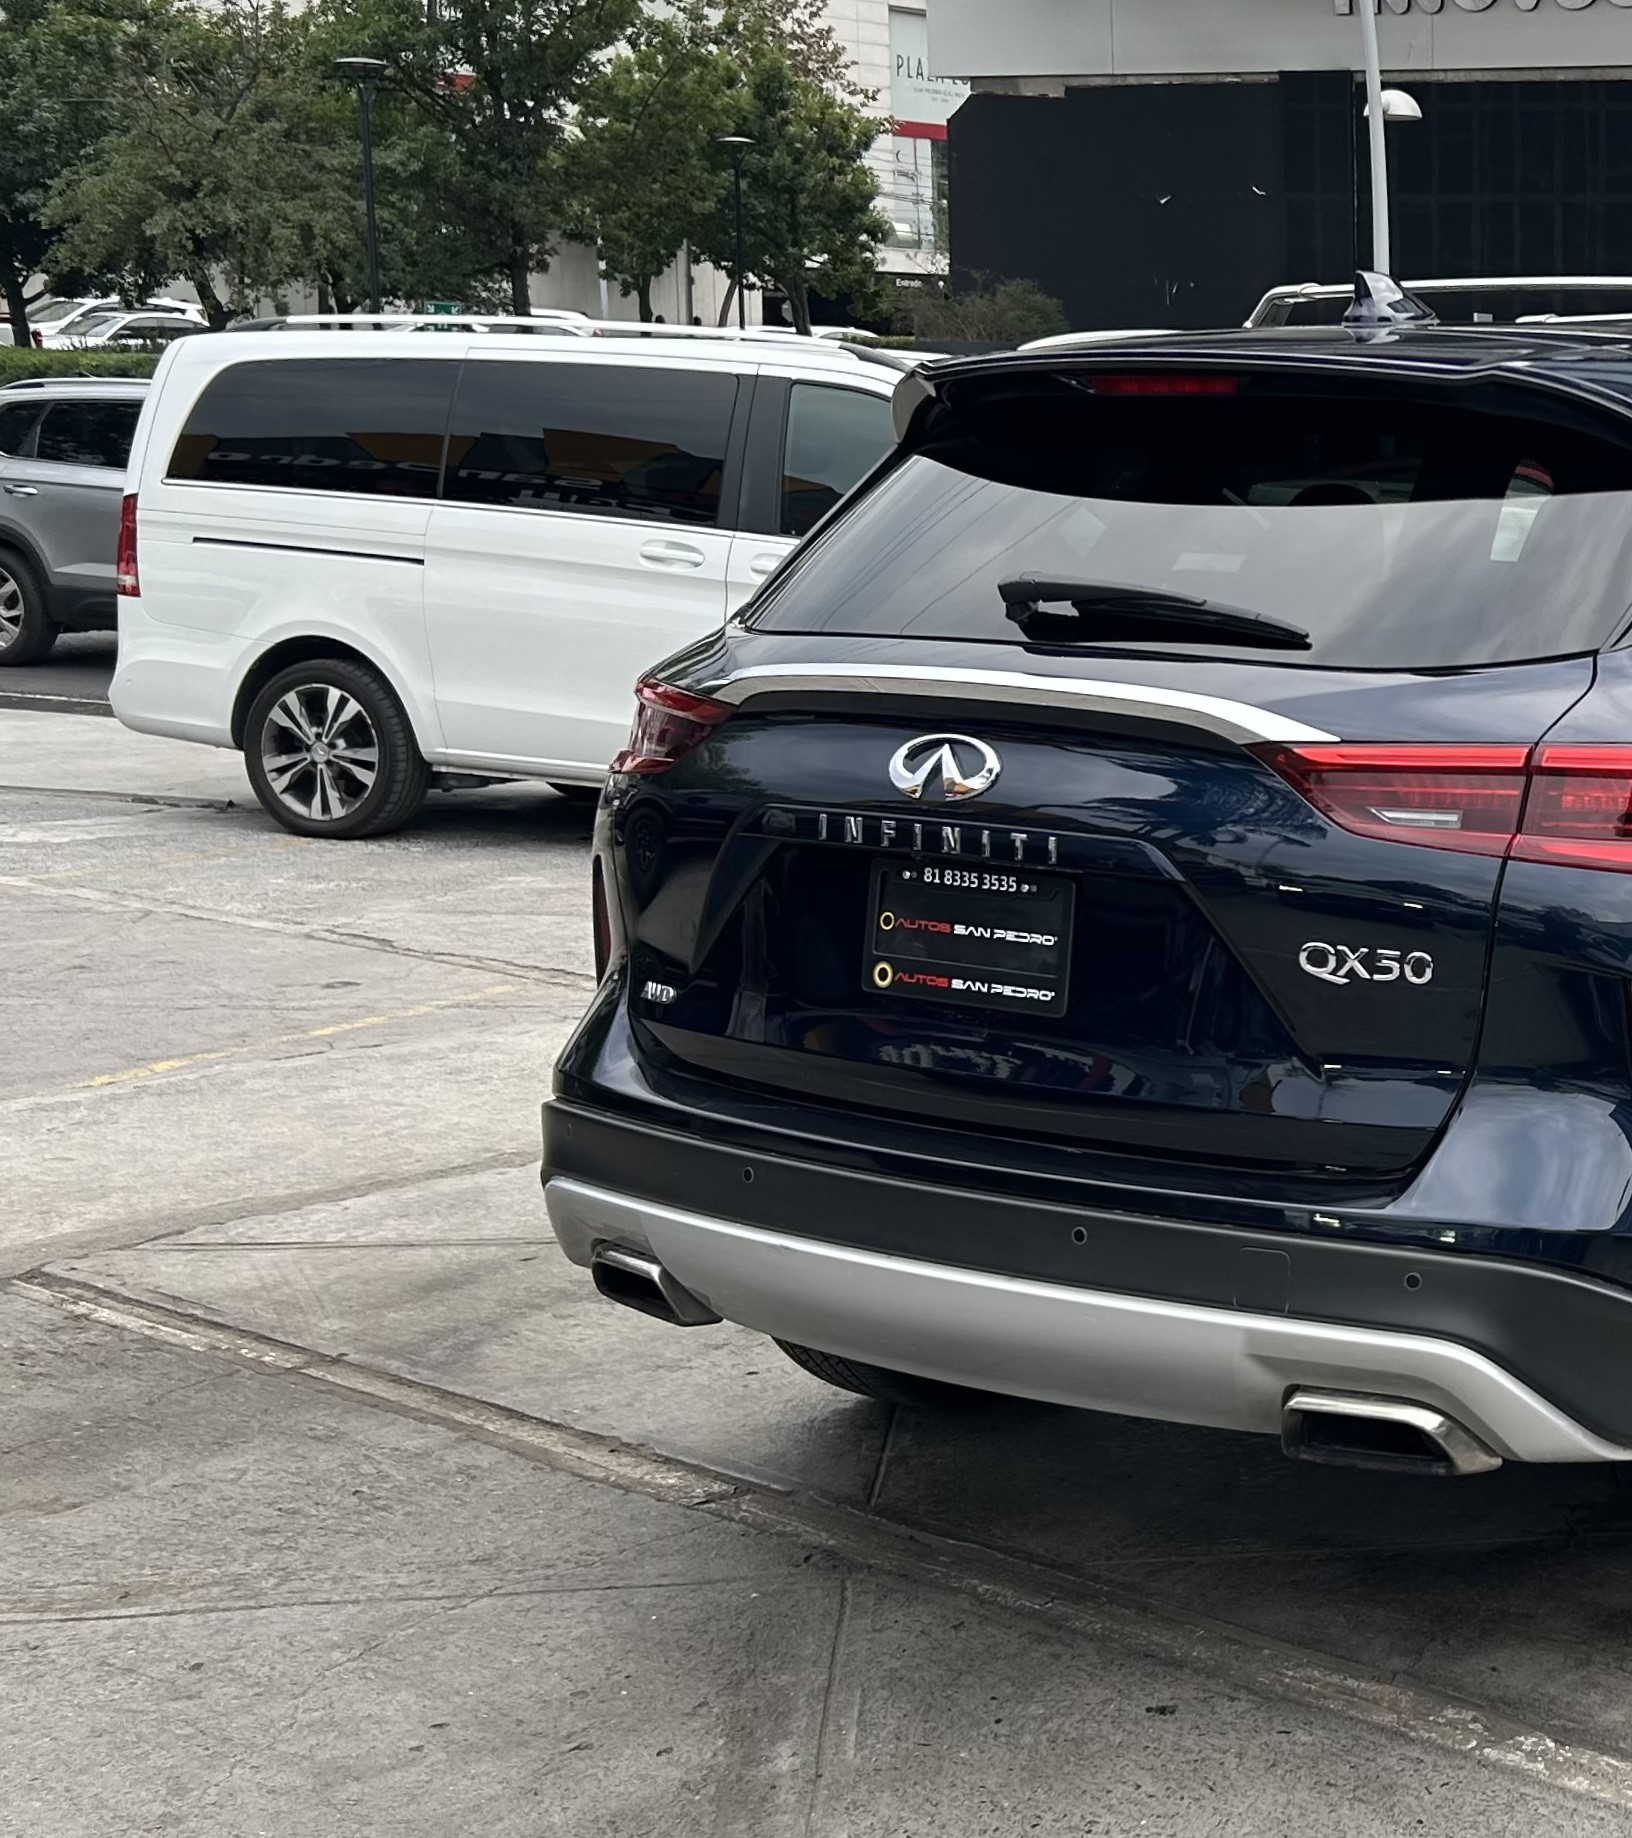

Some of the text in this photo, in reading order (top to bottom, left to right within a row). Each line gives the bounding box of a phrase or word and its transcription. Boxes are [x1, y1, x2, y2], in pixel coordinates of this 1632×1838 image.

[818, 813, 1058, 865] INFINITI
[923, 867, 1017, 893] 81 8335 3535
[895, 917, 951, 933] AUTOS
[953, 924, 991, 939] SAN
[1298, 941, 1434, 985] QX50
[640, 980, 677, 1005] AWD
[894, 971, 949, 987] AUTOS
[951, 978, 988, 993] SAN
